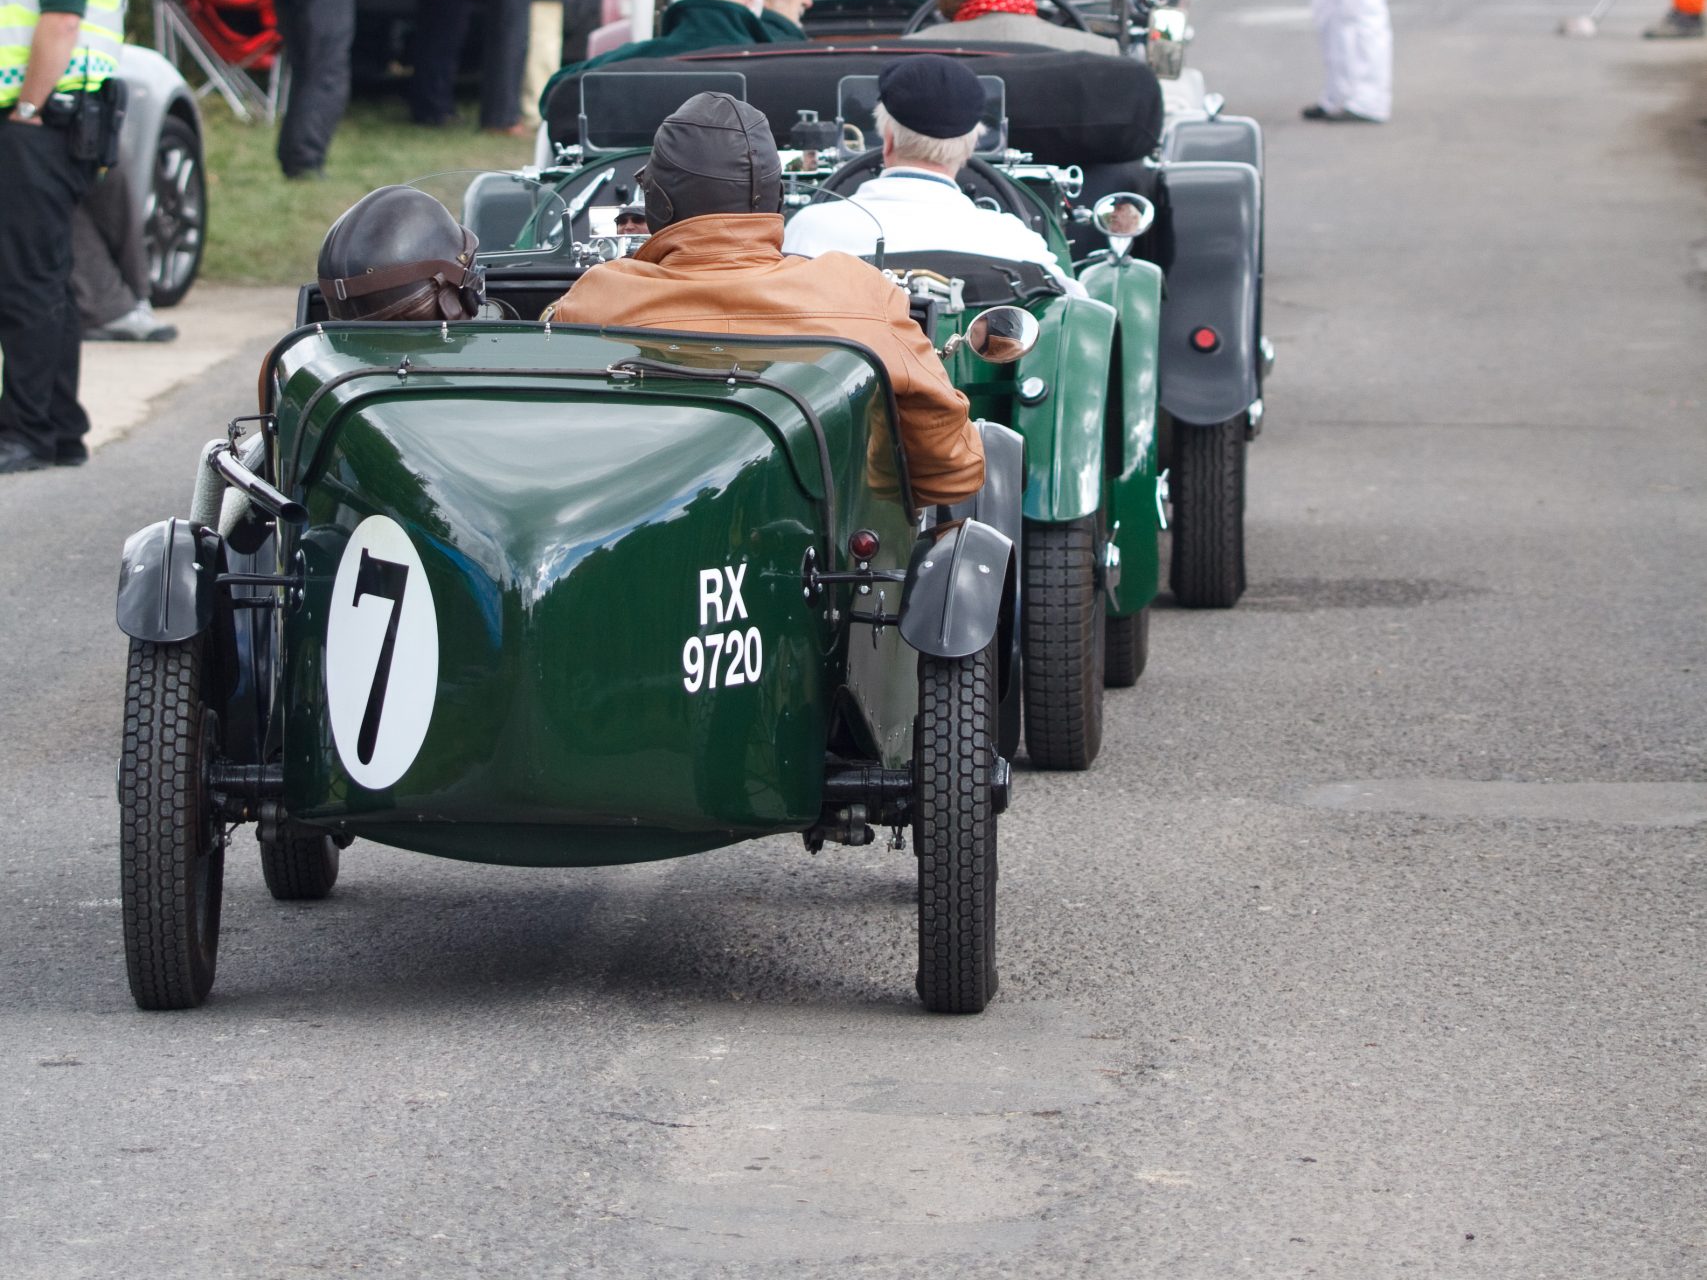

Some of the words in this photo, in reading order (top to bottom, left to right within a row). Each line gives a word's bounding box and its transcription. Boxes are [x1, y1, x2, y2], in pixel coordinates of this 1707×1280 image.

[699, 562, 749, 626] RX
[352, 548, 410, 766] 7
[682, 626, 763, 694] 9720
